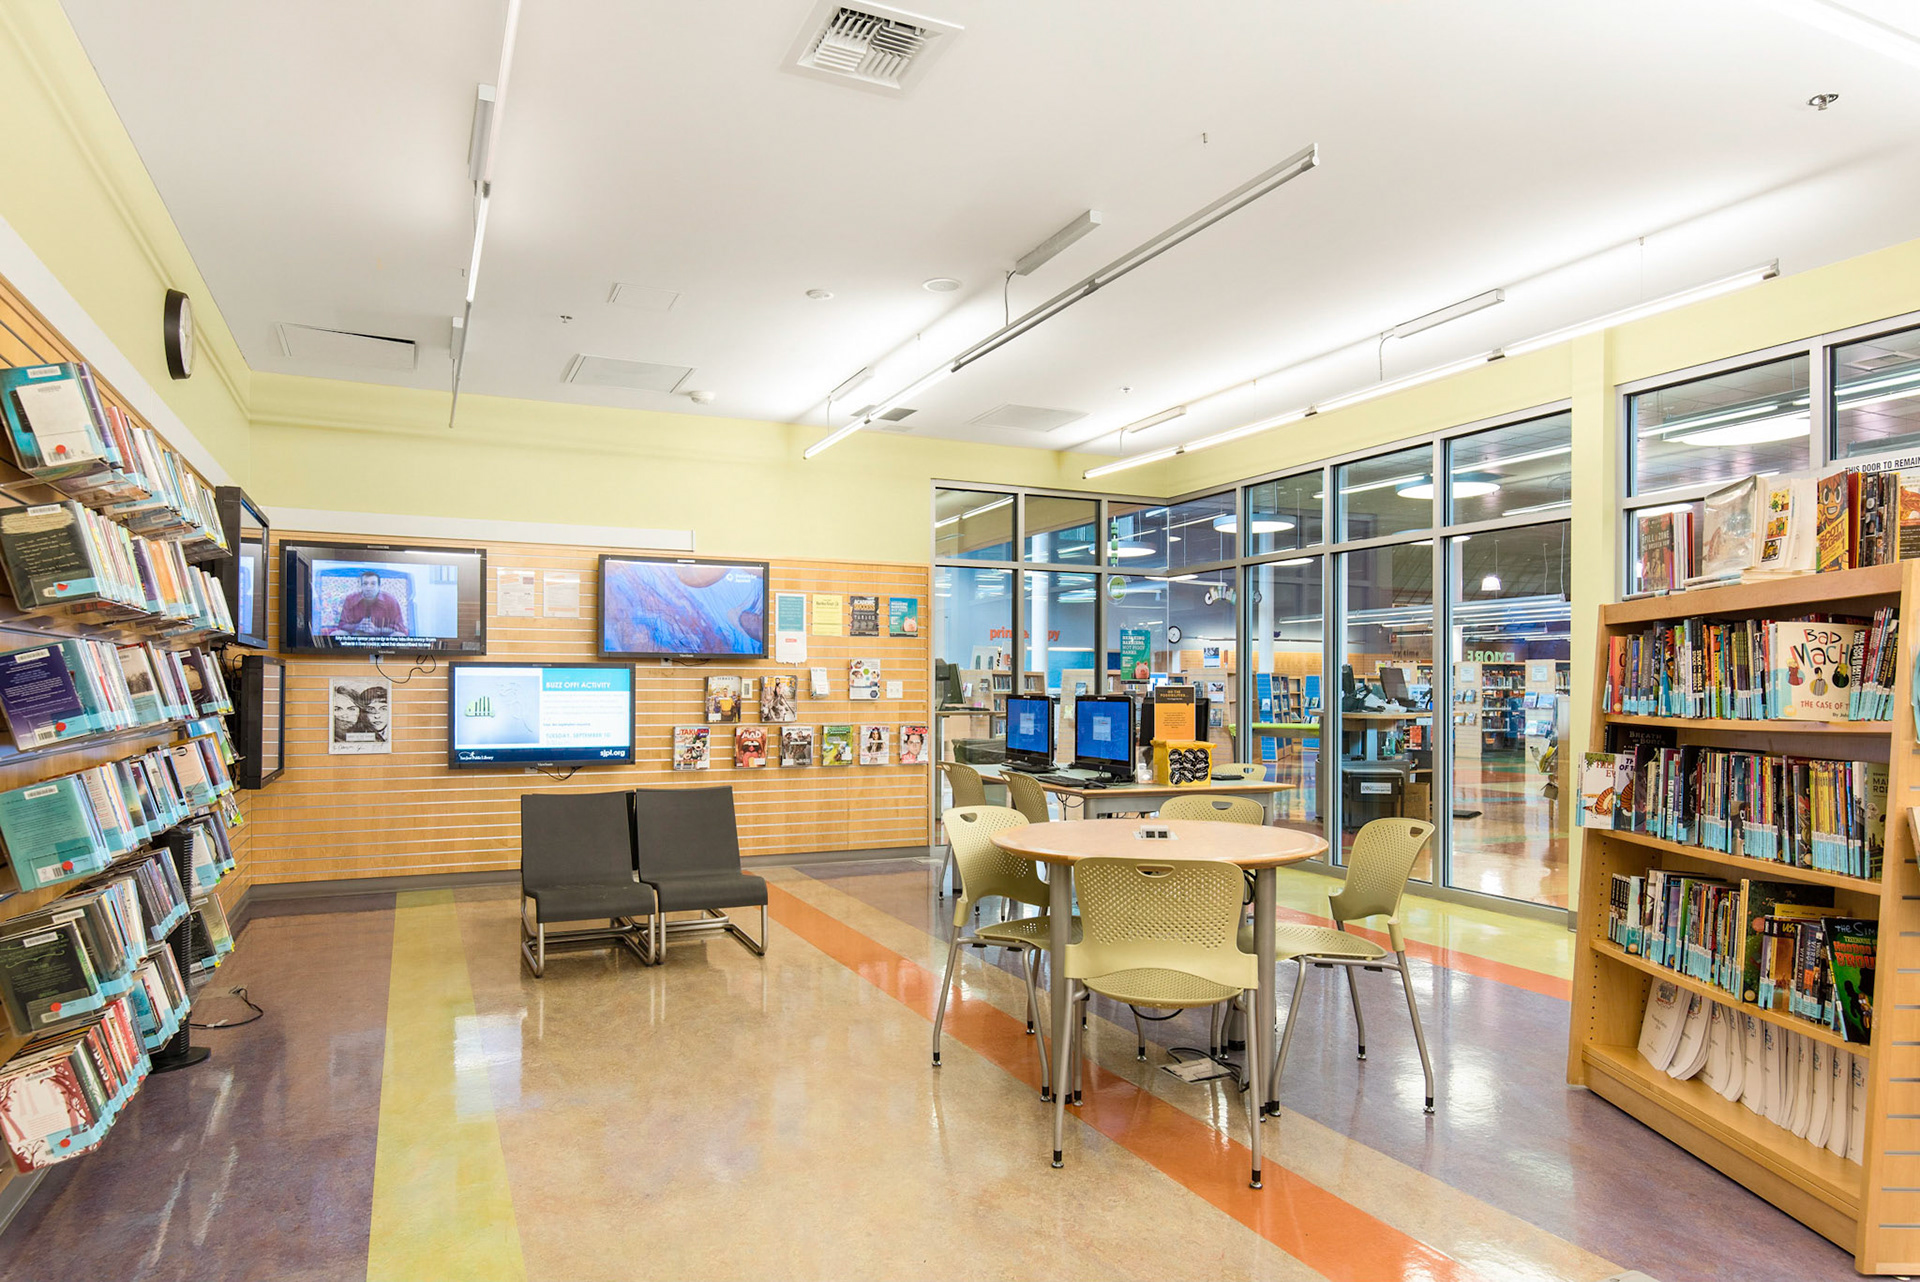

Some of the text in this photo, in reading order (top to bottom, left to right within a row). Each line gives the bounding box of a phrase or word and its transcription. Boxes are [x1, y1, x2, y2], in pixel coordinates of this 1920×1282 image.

[1862, 462, 1881, 473] DOOR
[1883, 460, 1893, 469] TO
[1821, 518, 1845, 539] SCOTT
[1820, 529, 1845, 552] PILGRIM
[989, 626, 1013, 641] prin
[545, 681, 563, 689] BUZZ
[581, 681, 612, 689] ACTIVITY
[1800, 700, 1813, 708] THE
[1815, 700, 1832, 710] CASE
[1834, 702, 1843, 710] OF
[741, 730, 762, 739] MAD
[1629, 731, 1662, 740] BREATH
[600, 749, 626, 758] sjpl.org
[1835, 951, 1876, 970] BROU
